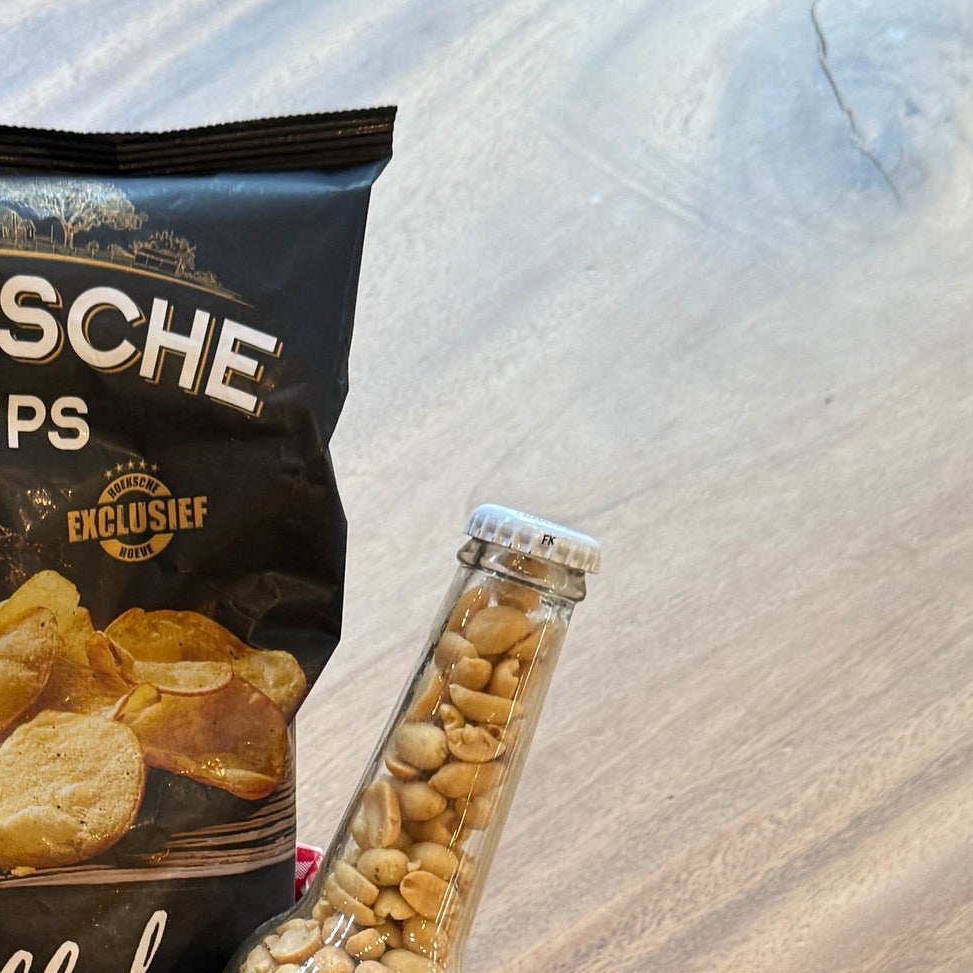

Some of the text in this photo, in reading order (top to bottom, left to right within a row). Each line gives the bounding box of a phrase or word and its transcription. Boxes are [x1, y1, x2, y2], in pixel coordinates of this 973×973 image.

[107, 476, 160, 500] HOEKSCHE
[66, 496, 208, 544] EXCLUSIEF
[541, 534, 556, 546] FK
[119, 544, 154, 560] HOEVE
